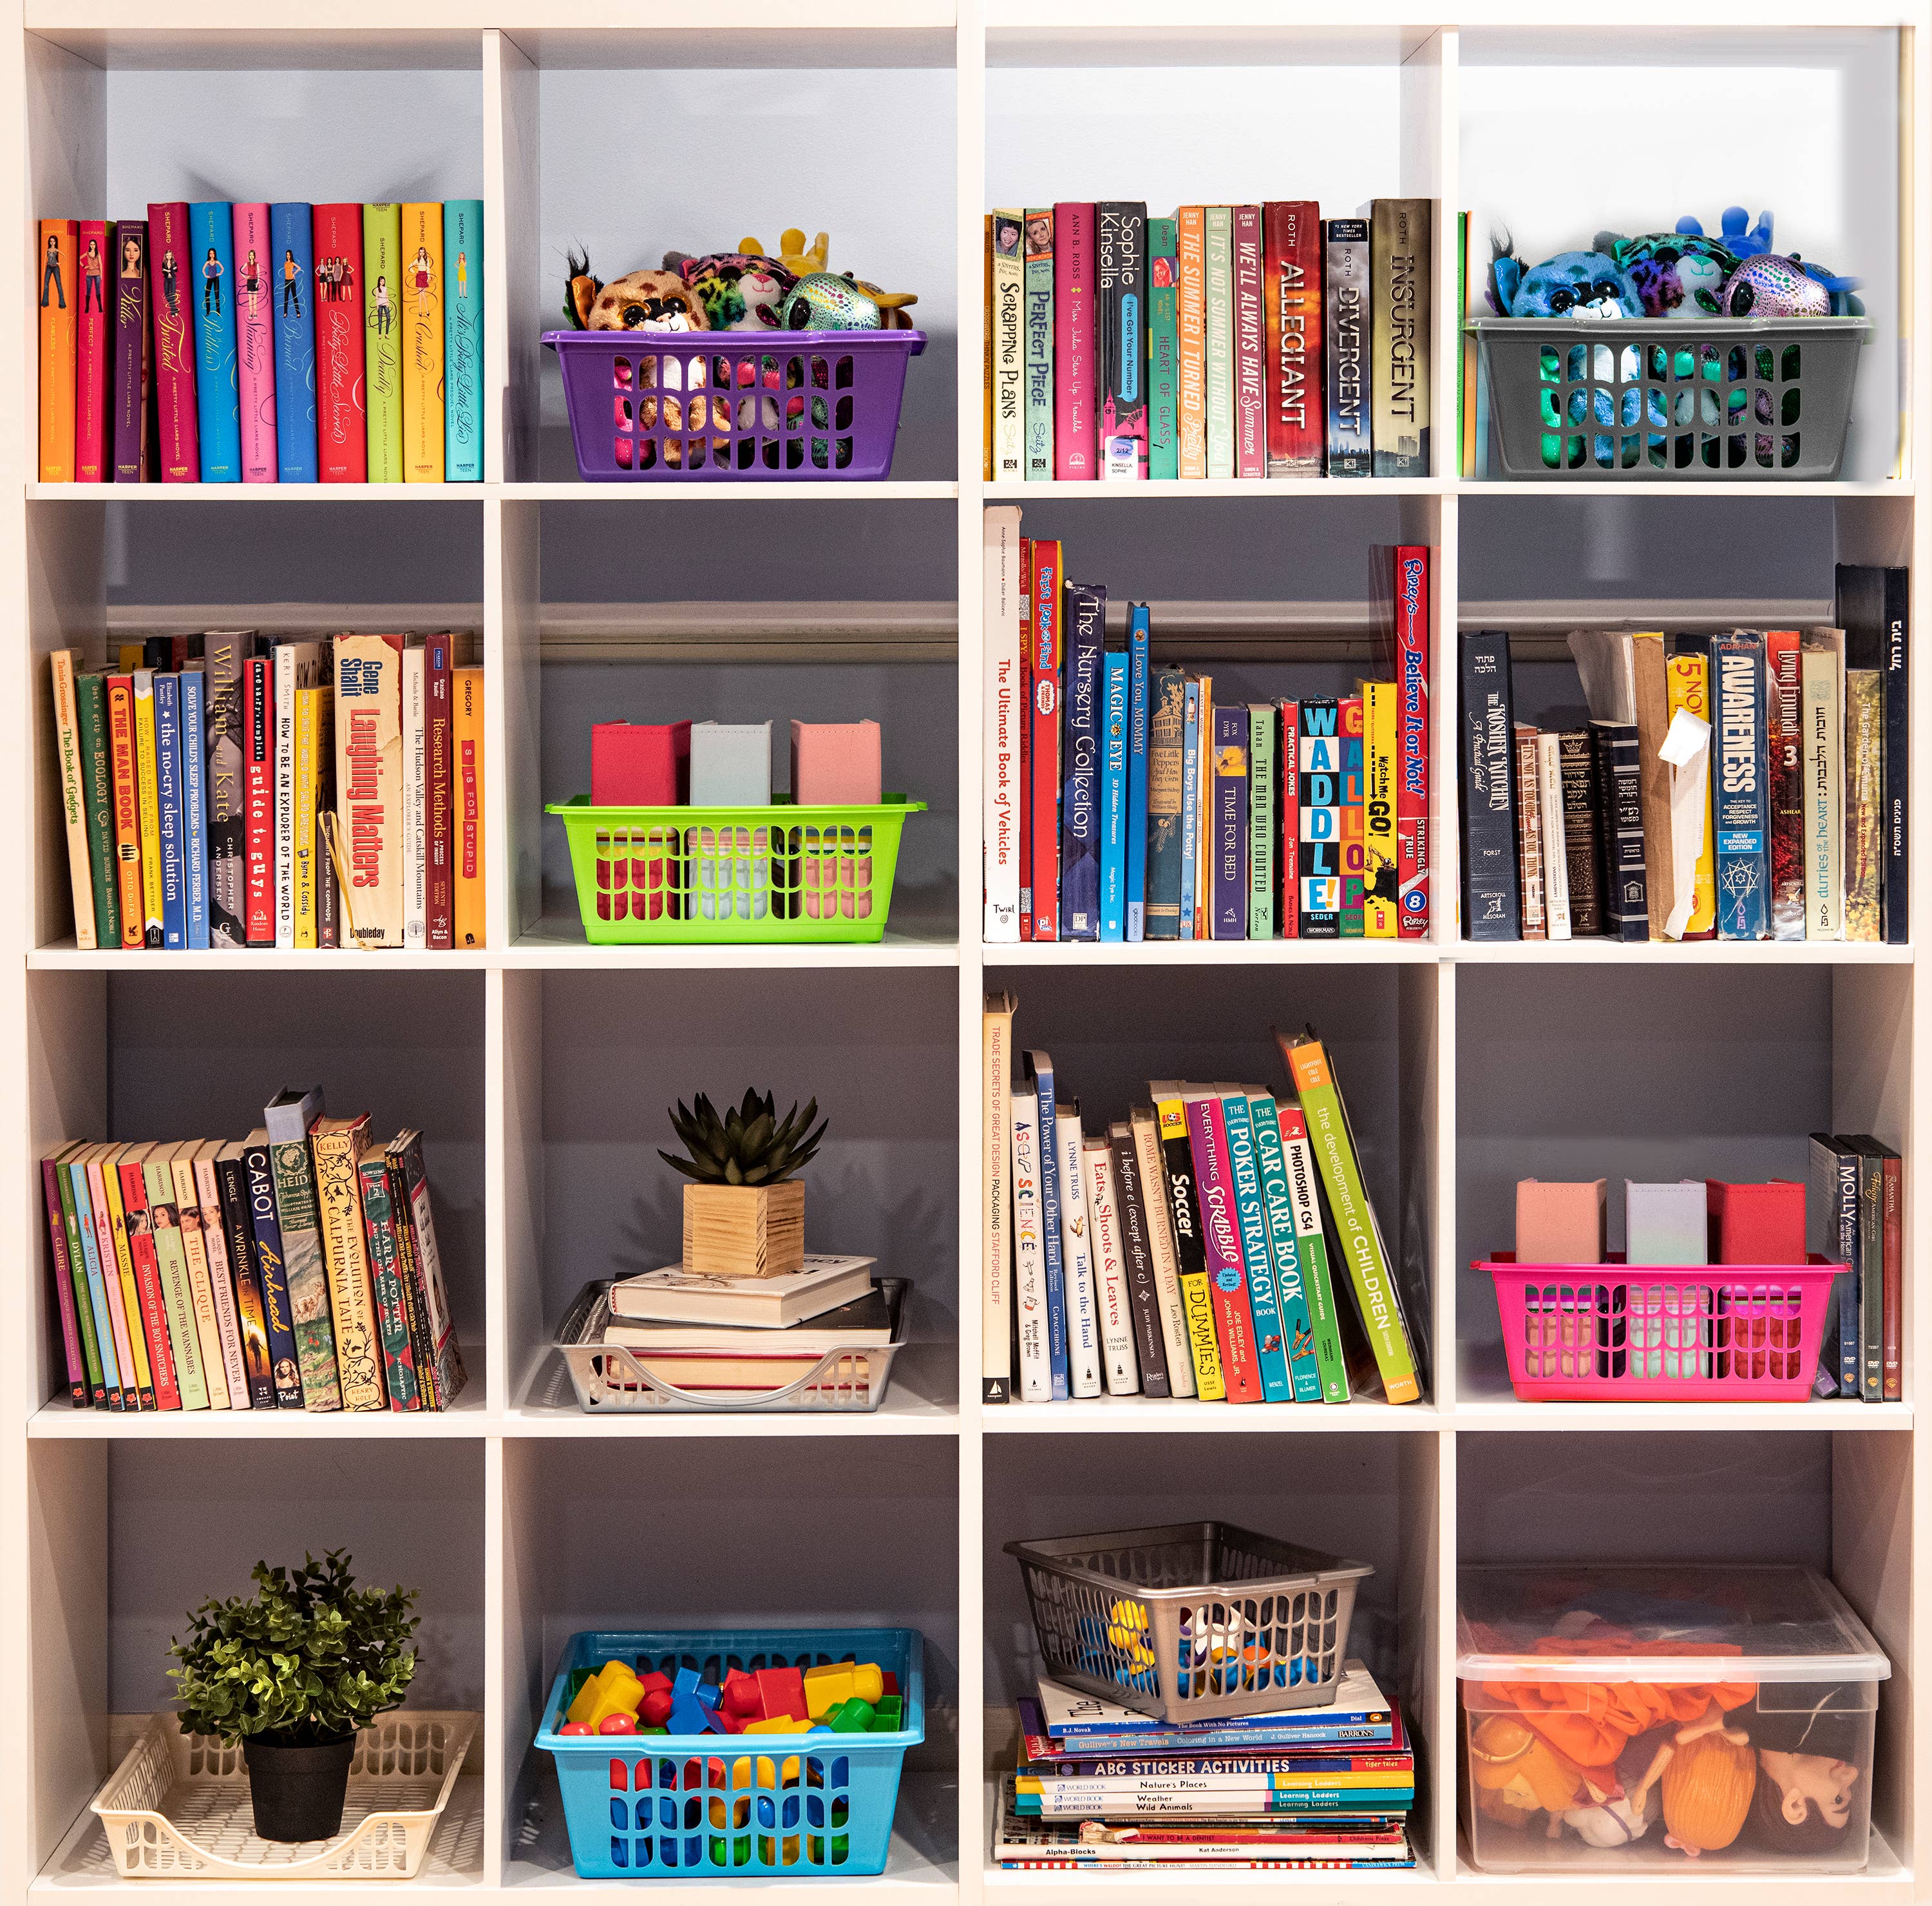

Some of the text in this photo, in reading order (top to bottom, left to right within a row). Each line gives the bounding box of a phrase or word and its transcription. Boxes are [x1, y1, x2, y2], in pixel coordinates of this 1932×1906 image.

[1072, 240, 1079, 250] B.
[1101, 213, 1120, 289] Kinsella
[1116, 216, 1141, 285] Sophie
[120, 283, 142, 329] Killer
[1240, 242, 1262, 455] WE'LL ALWAYS HAVE Summer
[1281, 260, 1305, 430] ALLEGIANT
[1339, 287, 1361, 435] DIVERGENT
[1390, 255, 1416, 423] INSURGENT
[1068, 301, 1083, 434] Miss Julia Stirs Up Trouble
[1159, 336, 1170, 444] HEART OF GLASS
[340, 658, 363, 698] Shalit
[363, 661, 383, 694] Gene
[1475, 664, 1496, 673] הלכה
[214, 644, 234, 823] William and Kate
[281, 718, 290, 738] HOW
[1109, 667, 1124, 771] MAGIC EYE
[1405, 649, 1425, 795] Believe It or Not!
[1721, 656, 1756, 793] AWARENESS
[114, 709, 133, 830] THE MAN BOOK
[280, 774, 290, 788] AN
[281, 756, 290, 768] BE
[433, 718, 446, 837] Research Methods
[466, 772, 473, 783] IS
[994, 660, 1010, 865] The Ultimate Book of Vehicles
[1112, 778, 1119, 788] 3D
[1379, 756, 1388, 799] Watch Me
[160, 723, 180, 902] the no-cry sleep solution
[280, 793, 290, 841] EXPLORER
[345, 709, 384, 887] Laughing Matters
[1368, 801, 1392, 837] GO!
[281, 846, 290, 858] OF
[1225, 787, 1236, 881] TIME FOR BED
[1405, 835, 1414, 859] TRUE
[1417, 819, 1426, 875] STRIKINGLY
[280, 863, 290, 881] THE
[281, 885, 290, 920] WORLD
[1409, 894, 1422, 910] 8
[319, 1140, 349, 1151] KELLY
[1068, 1141, 1080, 1200] LYNNE TRUSS
[247, 1152, 273, 1221] CABOT
[1172, 1174, 1193, 1237] Soccer
[1290, 1145, 1314, 1230] PHOTOSHOP CS4
[1840, 1166, 1855, 1221] MOLLY
[1099, 1205, 1112, 1253] Shoots
[1231, 1127, 1273, 1306] POKER STRATEGY
[1258, 1130, 1303, 1304] CAR CARE BOOK
[1317, 1107, 1392, 1330] the development of CHILDREN
[72, 1242, 82, 1273] DYLAN
[118, 1244, 131, 1277] MASSIE
[189, 1237, 211, 1323] THE CLIQUE
[1104, 1257, 1117, 1272] &
[259, 1241, 289, 1333] Airhead
[1076, 1253, 1092, 1349] Talk to the Hand
[1106, 1275, 1119, 1326] Leaves
[1095, 1759, 1290, 1775] ABC STICKER ACTIVITIES
[1141, 1781, 1177, 1789] Nature's
[1365, 1760, 1381, 1768] tiger
